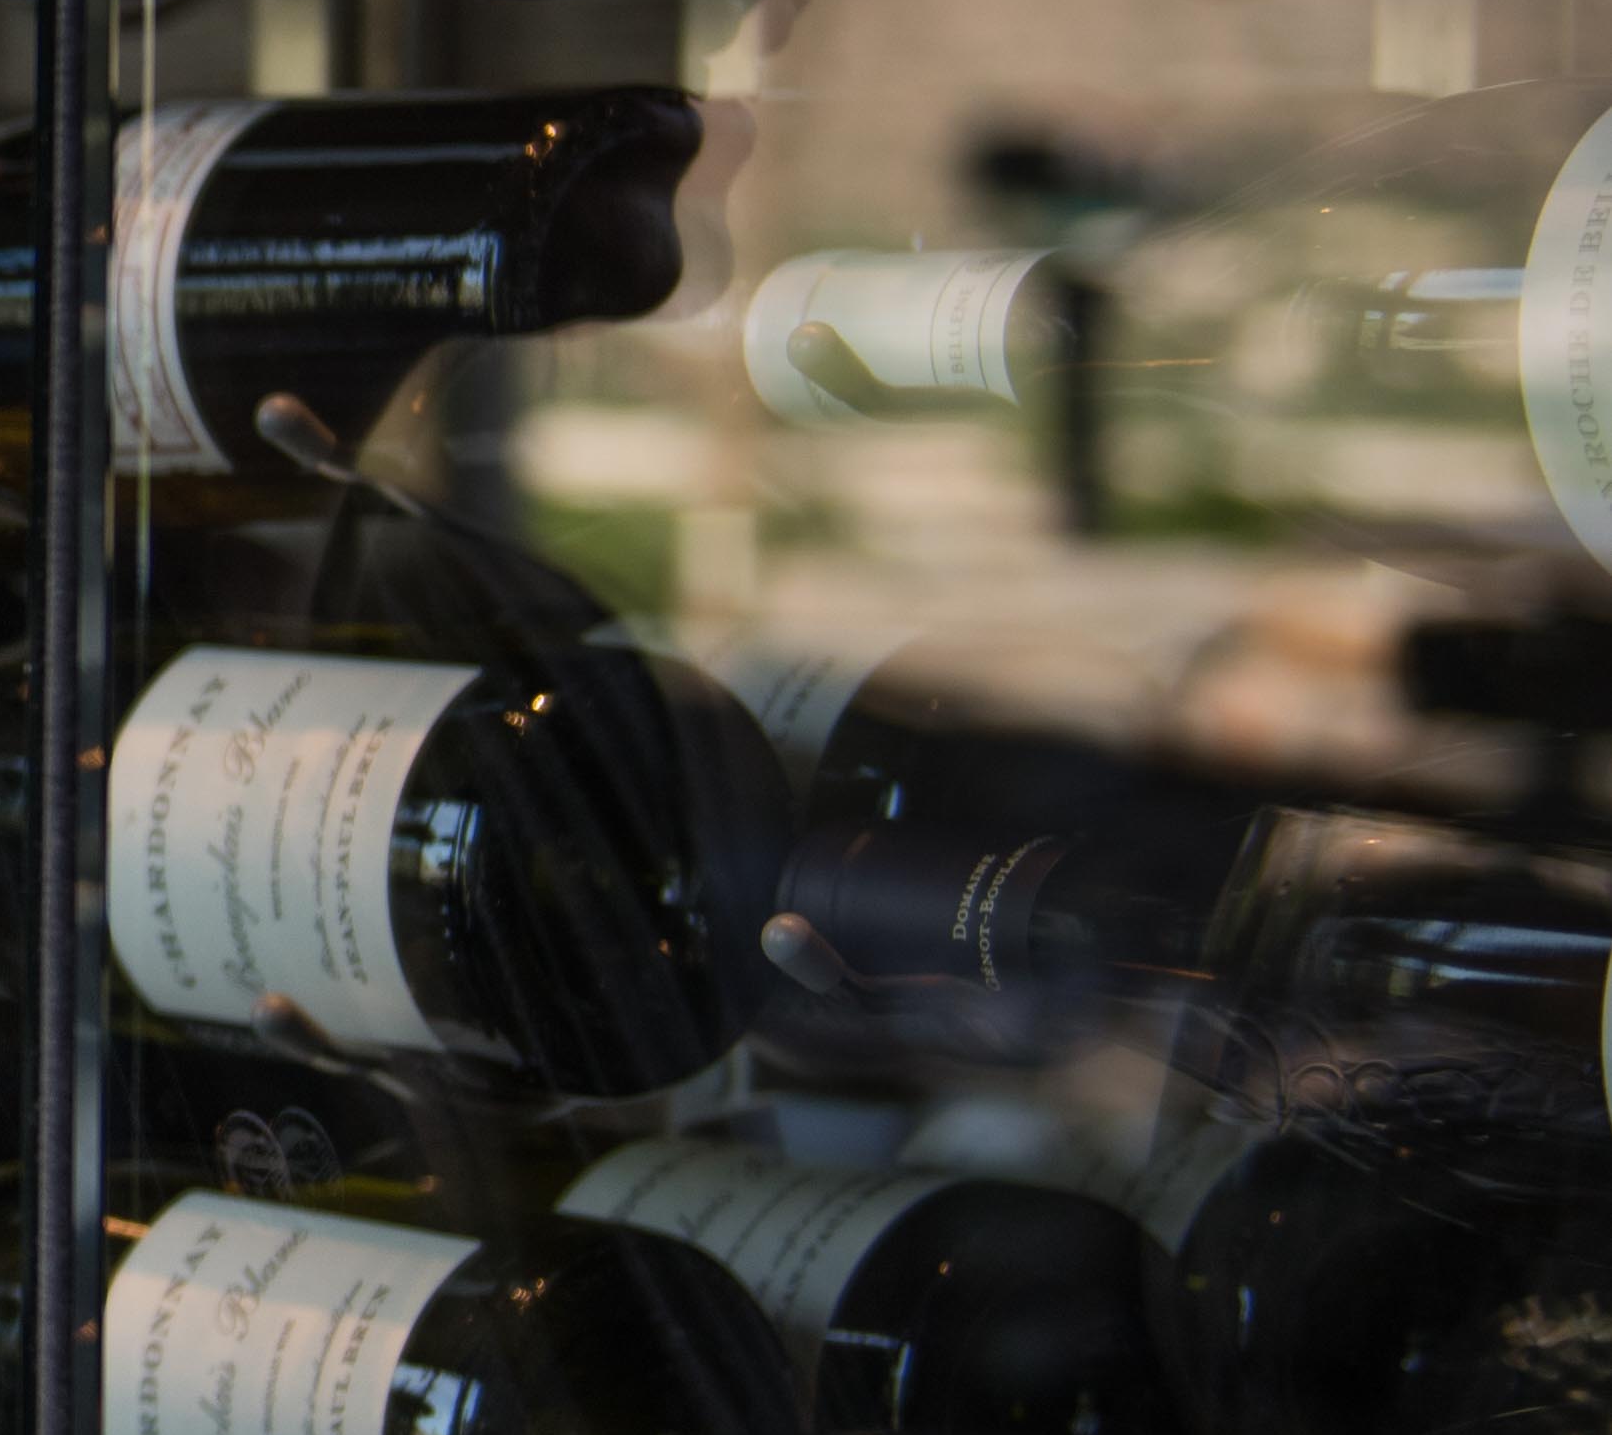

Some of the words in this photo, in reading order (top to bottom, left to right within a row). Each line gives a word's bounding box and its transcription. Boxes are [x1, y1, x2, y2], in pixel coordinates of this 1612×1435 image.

[1568, 264, 1595, 317] DE
[1567, 328, 1610, 468] ROCHE
[222, 670, 313, 785] Blanc
[348, 717, 394, 797] BRUN
[146, 675, 227, 991] CHARDONNAY
[335, 806, 369, 986] JEAN-PAUL
[344, 1283, 390, 1365] BRUN
